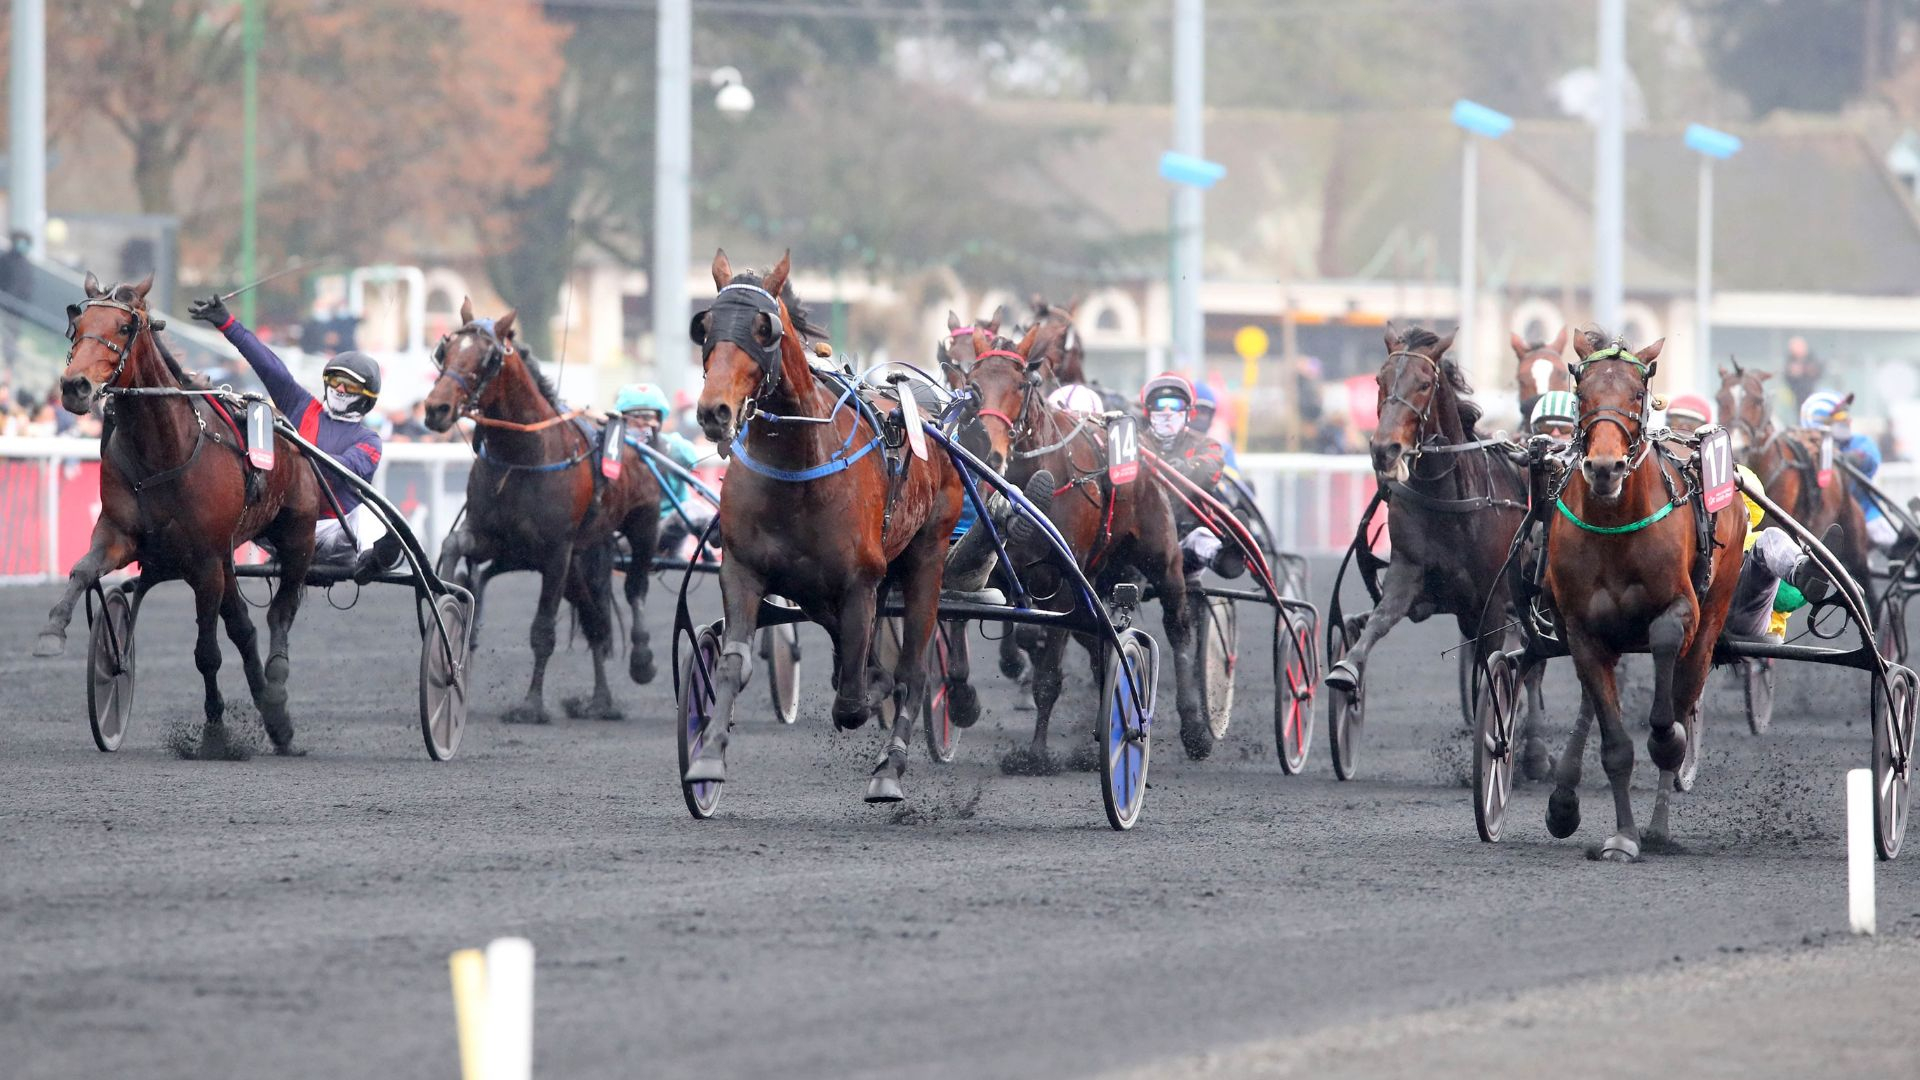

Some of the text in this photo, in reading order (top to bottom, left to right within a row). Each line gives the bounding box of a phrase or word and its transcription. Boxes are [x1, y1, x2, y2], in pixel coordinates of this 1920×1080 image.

[254, 406, 263, 448] 1
[608, 425, 620, 460] 4
[1110, 422, 1136, 464] 14
[1705, 436, 1727, 487] 17
